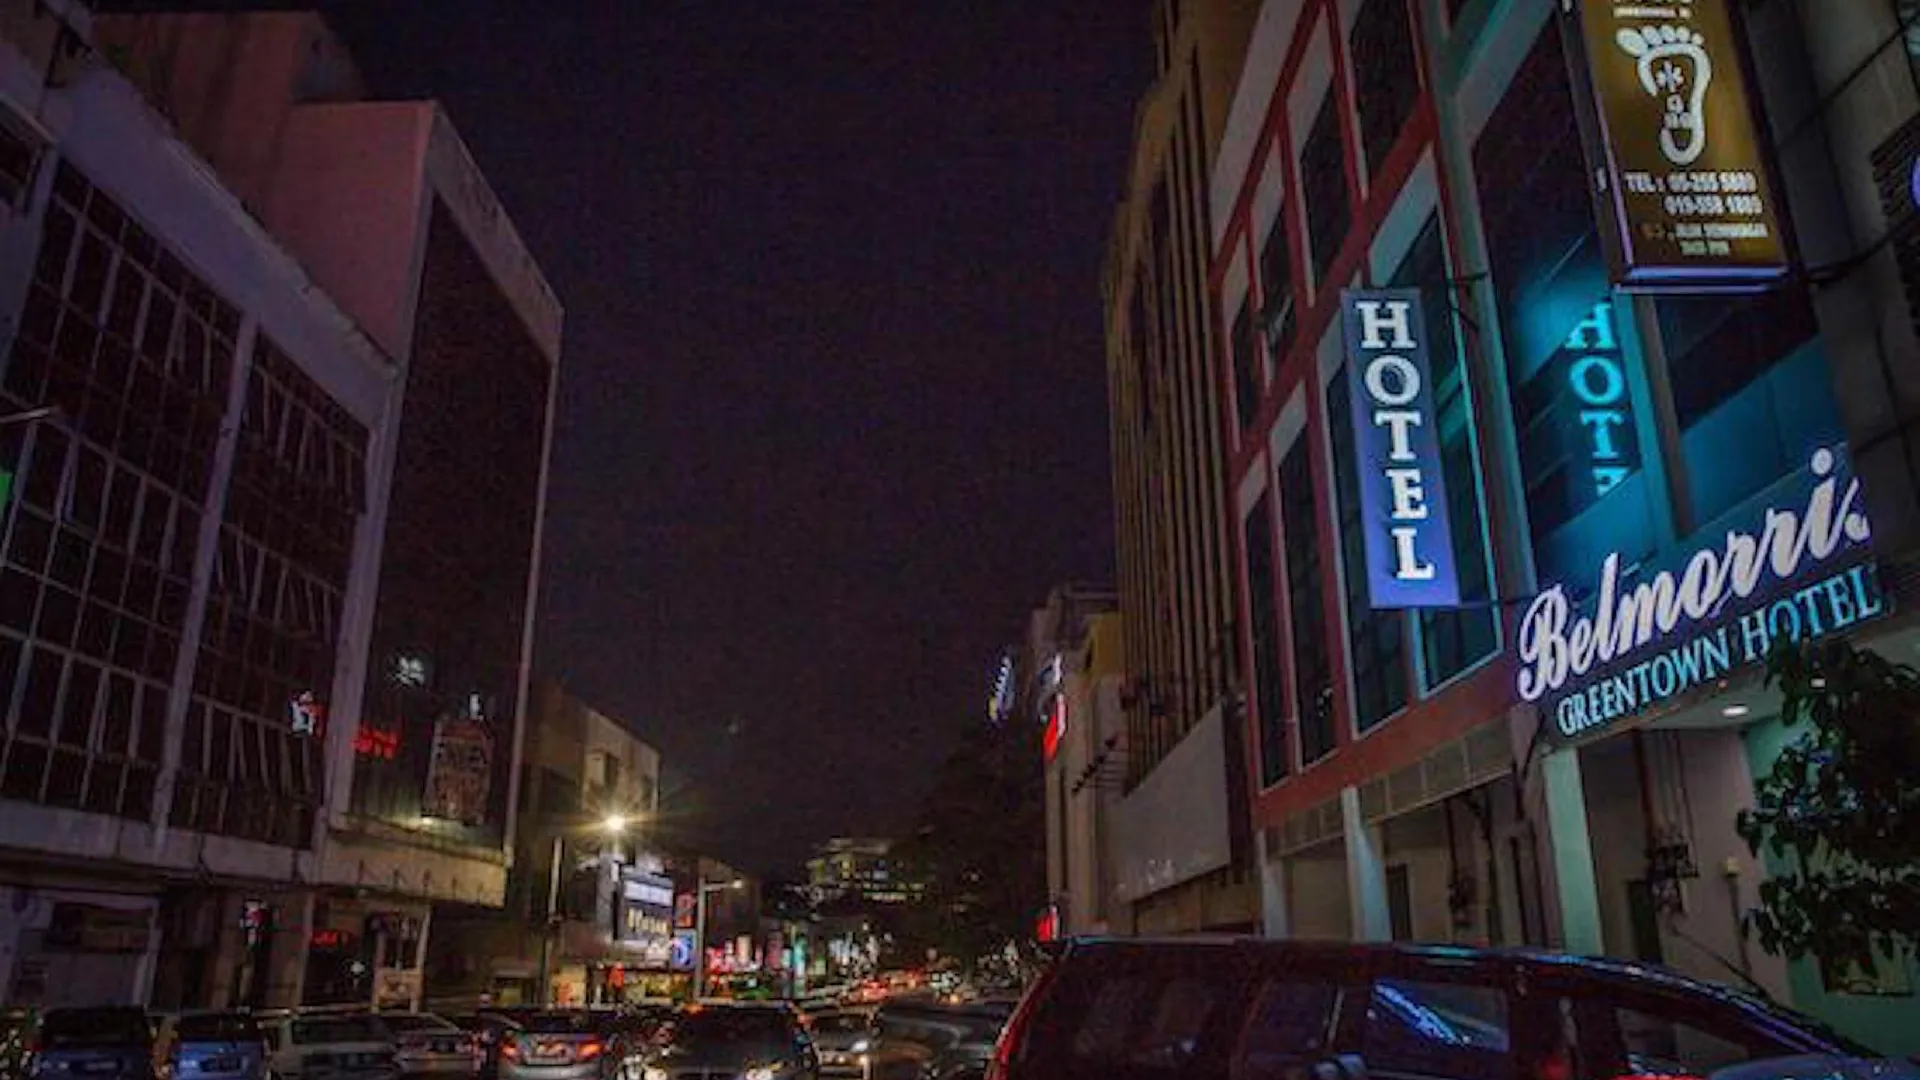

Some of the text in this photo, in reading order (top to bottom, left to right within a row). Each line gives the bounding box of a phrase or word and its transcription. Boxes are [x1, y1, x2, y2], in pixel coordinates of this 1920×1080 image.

[1355, 301, 1435, 580] HOTEL
[1558, 563, 1882, 737] GREENTOWN HOTEL
